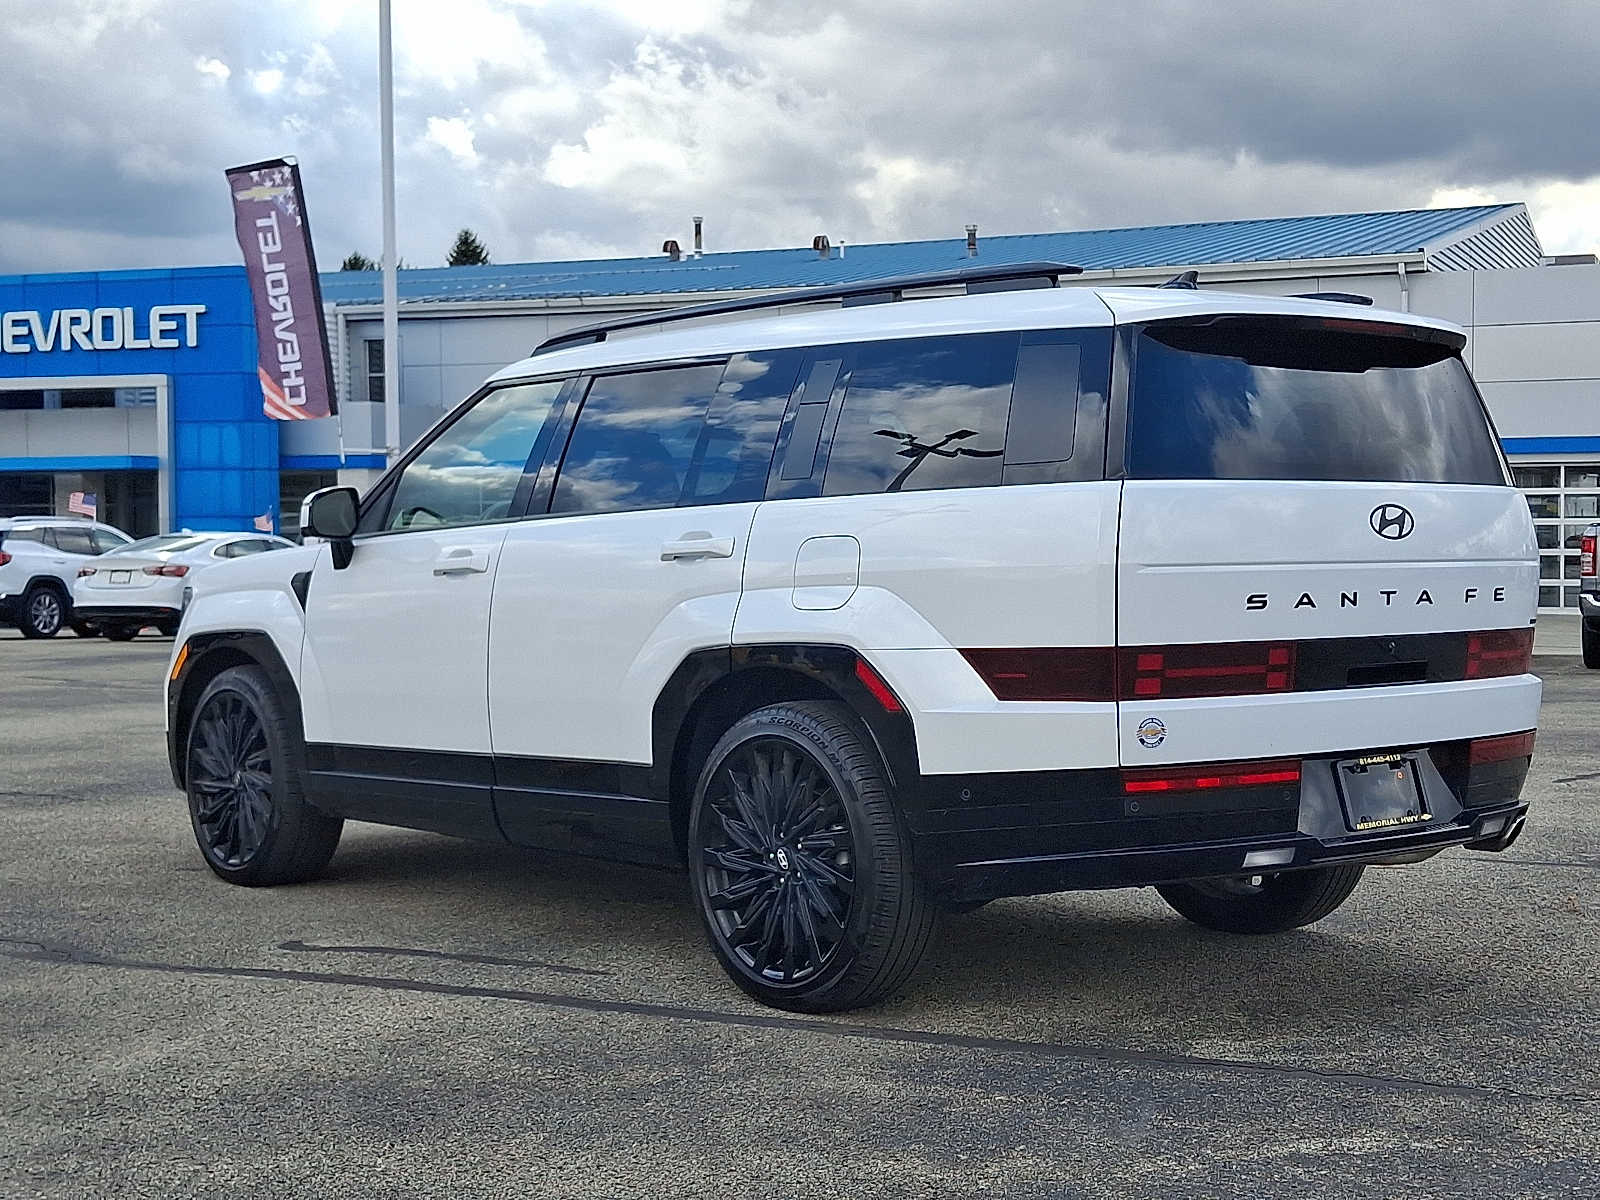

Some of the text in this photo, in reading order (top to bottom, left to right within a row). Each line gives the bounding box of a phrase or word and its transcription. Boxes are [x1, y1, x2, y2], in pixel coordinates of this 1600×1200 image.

[0, 304, 206, 354] EVROLET
[1245, 586, 1506, 611] SANTA FE
[768, 716, 829, 750] SCORPION
[1356, 814, 1419, 830] MEMORIAL HWY
